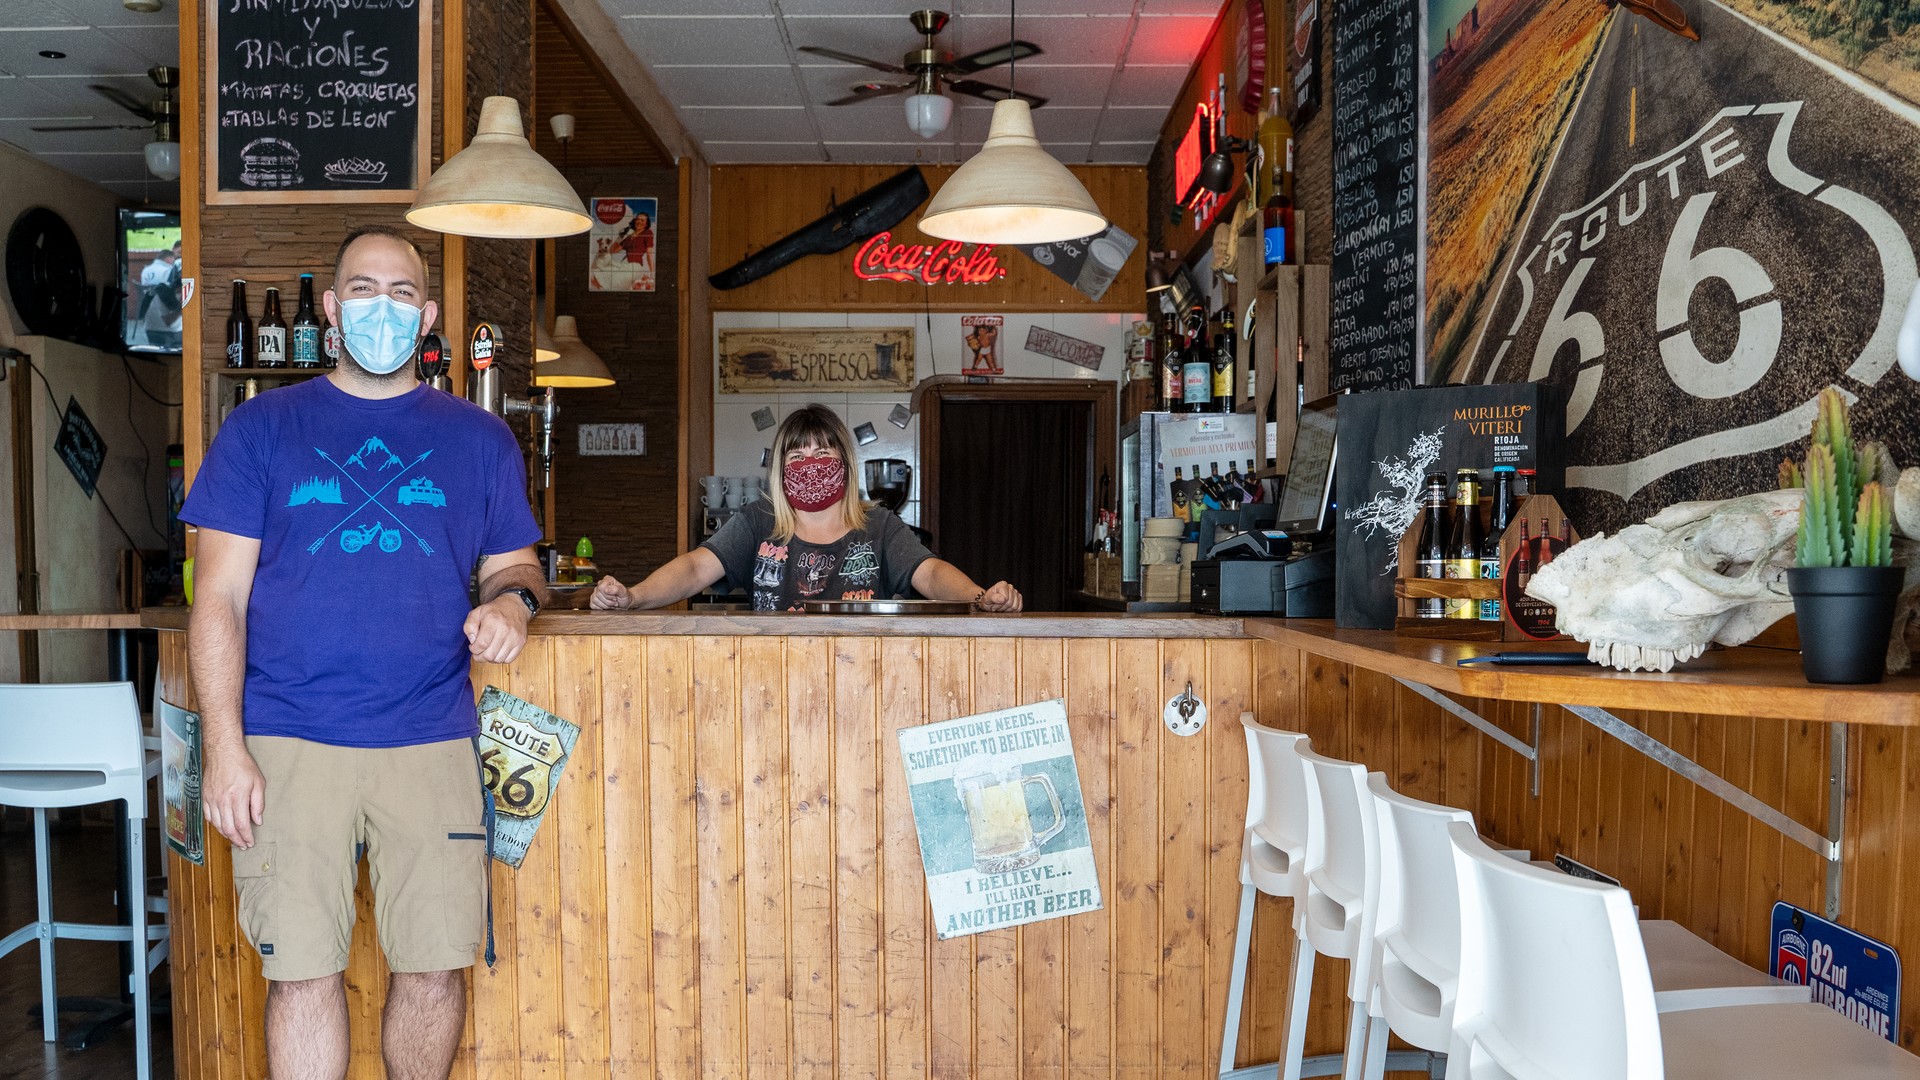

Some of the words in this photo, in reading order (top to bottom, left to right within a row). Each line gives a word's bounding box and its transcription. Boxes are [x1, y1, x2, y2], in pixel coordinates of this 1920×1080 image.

[303, 17, 320, 39] Y
[235, 30, 389, 77] RACIONES
[318, 80, 416, 108] CROQUETAS
[227, 108, 299, 129] TABLAS
[306, 110, 335, 129] DE
[1543, 127, 1745, 273] ROUTE
[854, 232, 1000, 284] Coca-Cola
[1034, 331, 1096, 363] WELCOME
[790, 352, 869, 381] ESPRESSO
[1453, 405, 1532, 420] MURILLO
[1469, 420, 1522, 435] VITERI
[1494, 436, 1519, 444] RIOJA
[798, 552, 835, 569] AC/DC
[489, 719, 551, 757] ROUTE
[928, 720, 992, 744] EVERYONE
[996, 711, 1047, 733] NEEDS...
[909, 741, 979, 770] SOMETHING
[981, 737, 997, 755] TO
[1000, 727, 1050, 752] BELIEVE
[1051, 724, 1066, 744] IN
[496, 830, 528, 851] EEDOM
[965, 880, 973, 894] I
[978, 864, 1072, 893] BELIEVE...
[985, 891, 1008, 906] I'LL
[1010, 883, 1053, 901] HAVE...
[946, 899, 1037, 932] ANOTHER
[1042, 888, 1092, 914] BEER
[1782, 933, 1806, 954] AIRBORNE
[1810, 939, 1847, 990] 82nd
